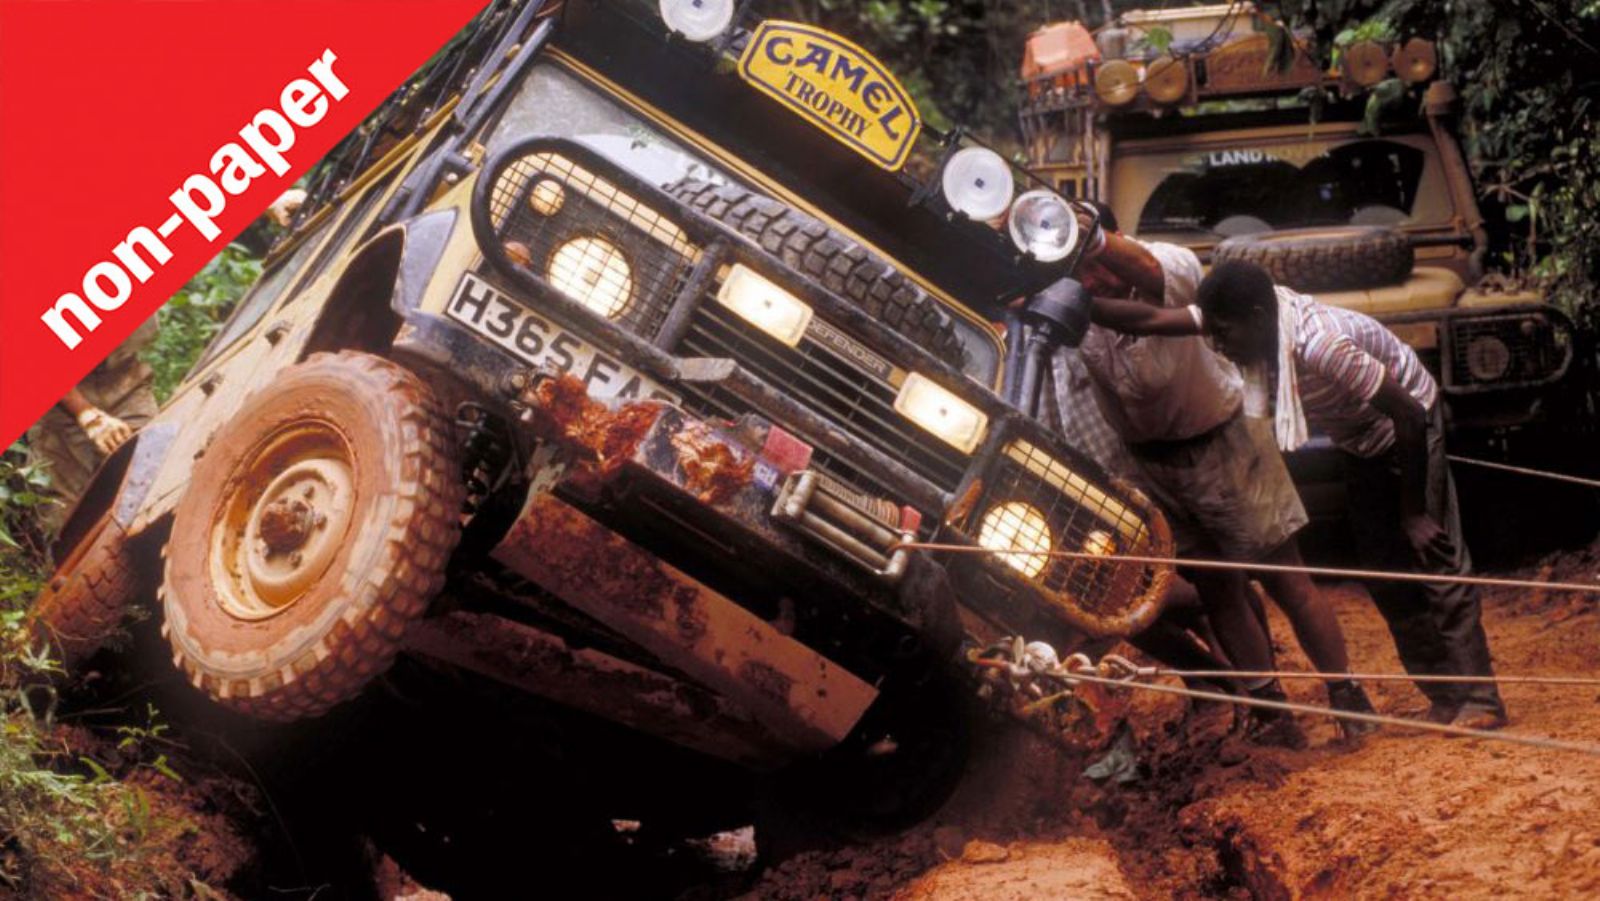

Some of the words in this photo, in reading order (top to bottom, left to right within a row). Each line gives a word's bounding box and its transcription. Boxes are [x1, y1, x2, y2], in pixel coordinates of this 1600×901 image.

[765, 36, 903, 141] CAMEL
[784, 70, 873, 138] TROPHY
[1209, 149, 1263, 167] LAND
[453, 278, 582, 373] H365
[583, 352, 675, 401] FA
